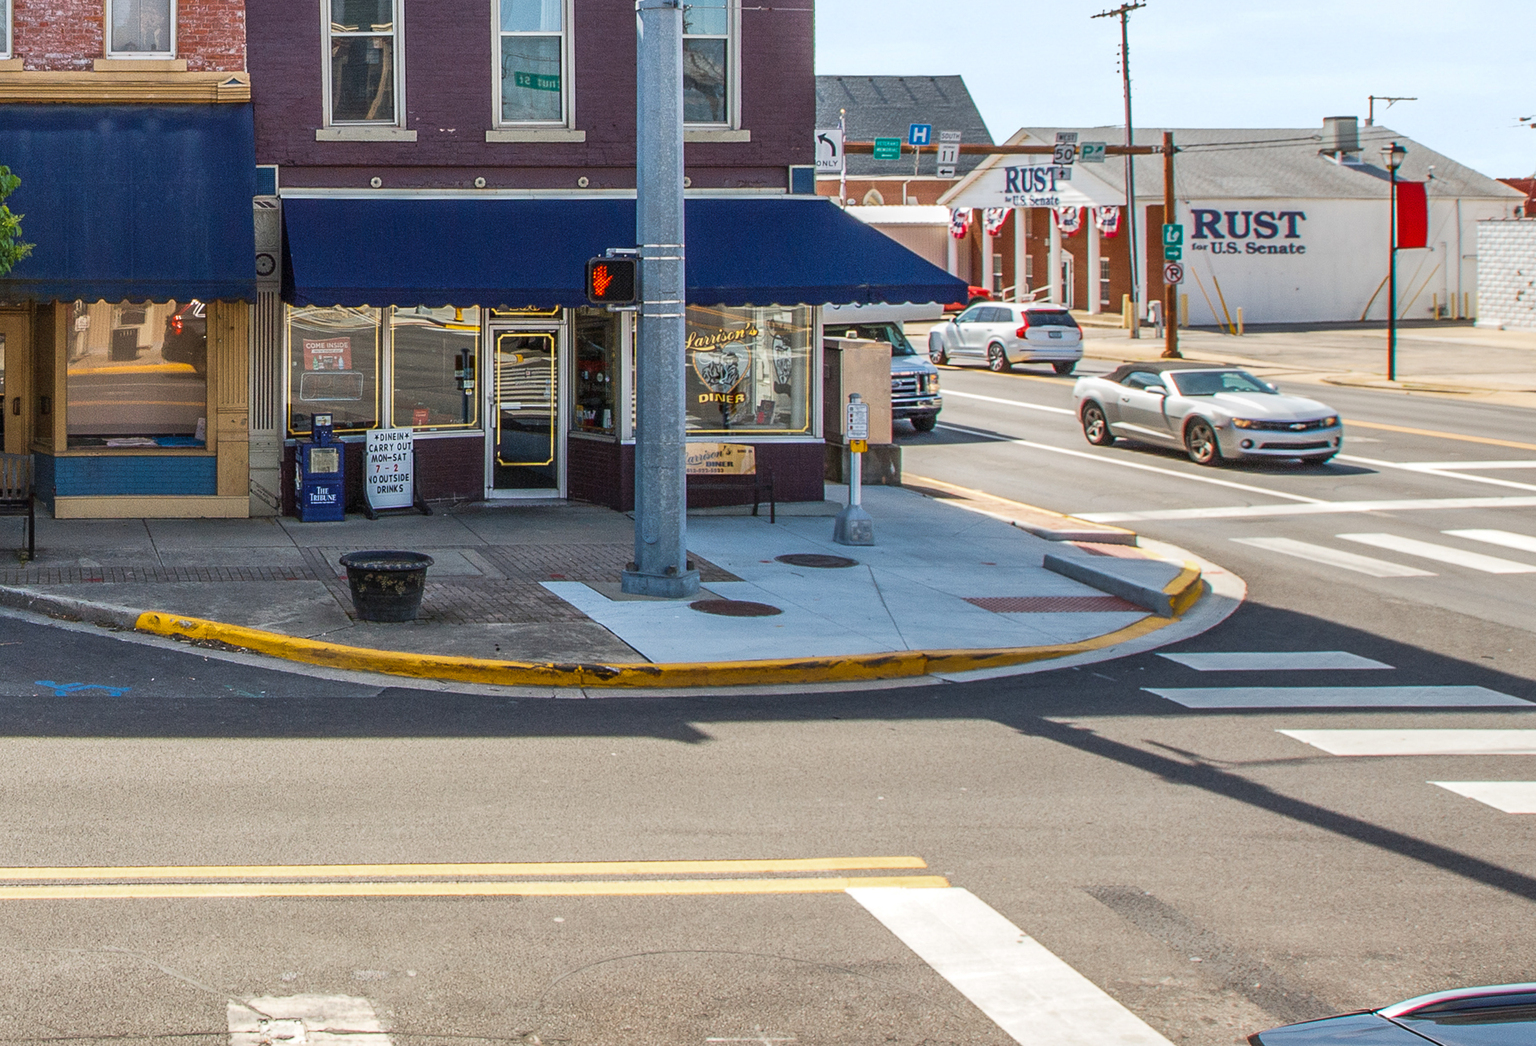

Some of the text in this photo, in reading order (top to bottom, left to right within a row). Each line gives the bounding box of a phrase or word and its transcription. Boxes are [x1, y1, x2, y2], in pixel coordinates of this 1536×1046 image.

[913, 127, 927, 143] H
[942, 150, 954, 162] 11
[1055, 148, 1073, 160] 50
[1005, 167, 1060, 193] RUST
[1029, 195, 1060, 206] Senate
[1190, 209, 1307, 239] RUST
[1191, 242, 1306, 254] for U.S. Senate
[685, 322, 758, 351] Larrison's
[698, 393, 746, 404] DINER
[368, 442, 412, 453] CARRY OUT
[371, 453, 407, 462] MON-SAT
[379, 474, 410, 483] OUTSIDE
[377, 484, 404, 494] DRINKS
